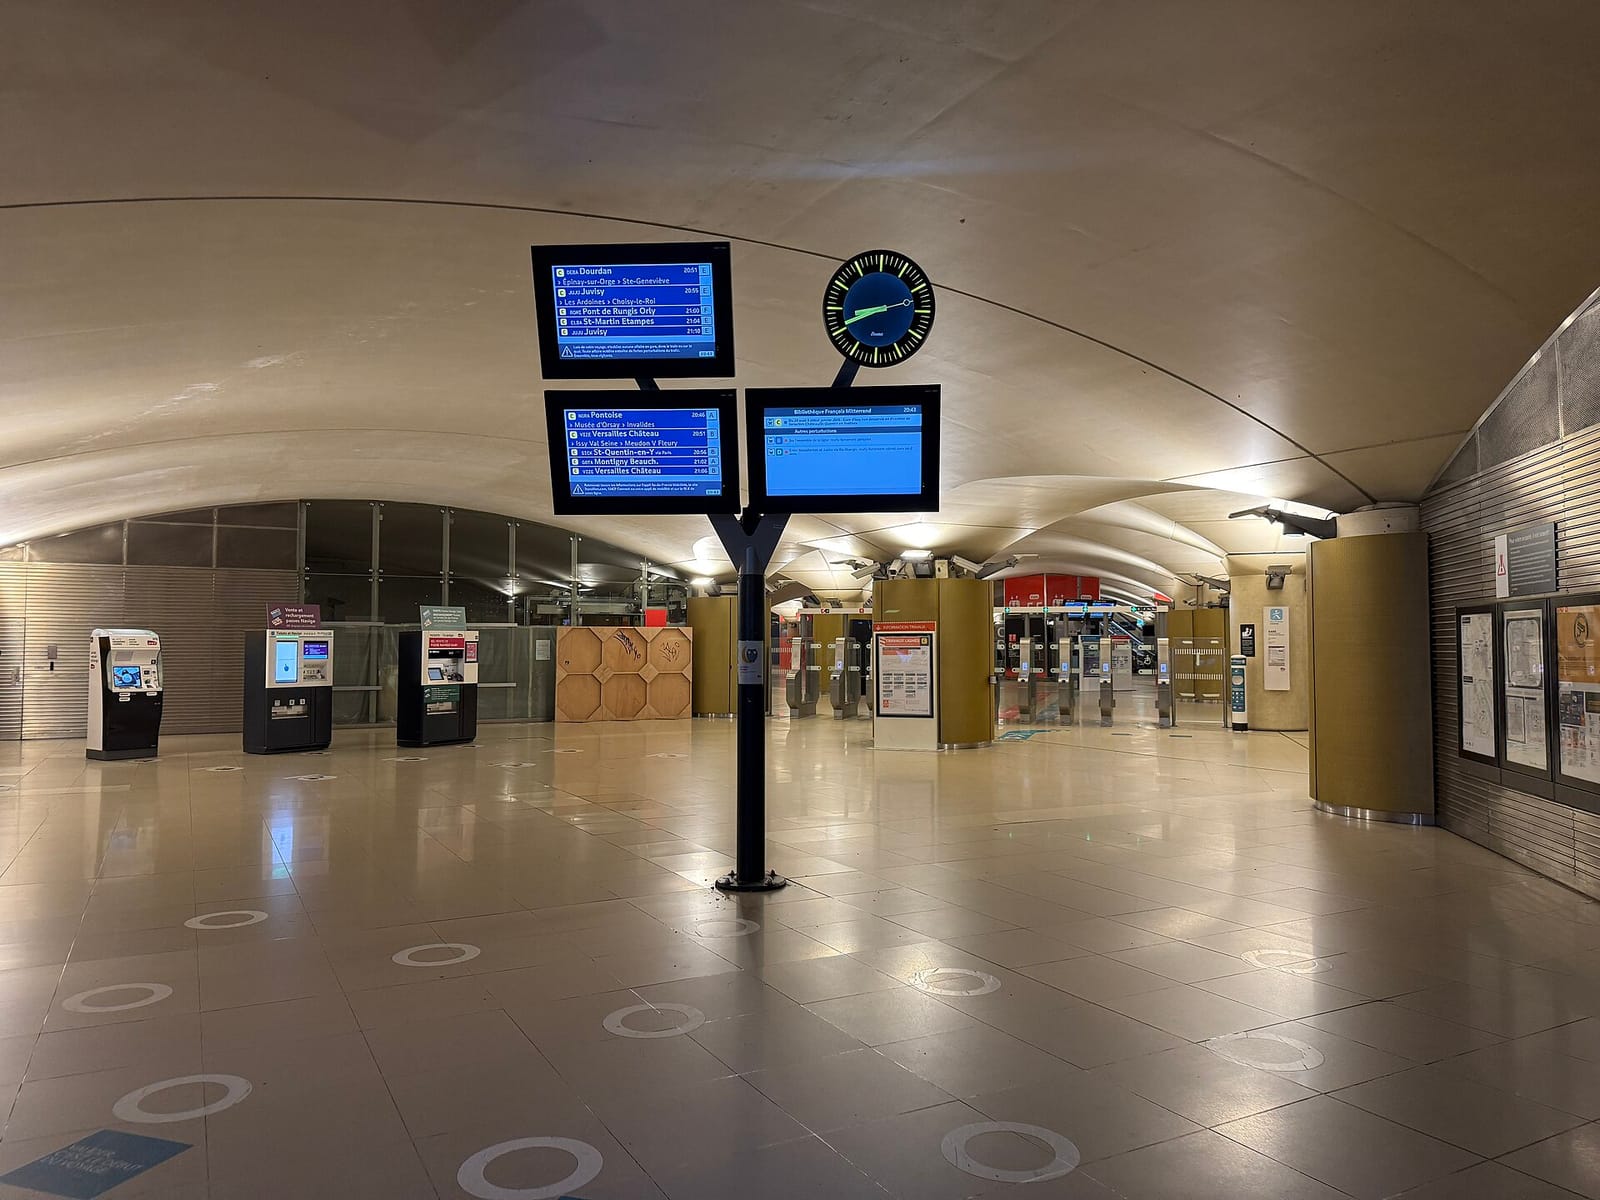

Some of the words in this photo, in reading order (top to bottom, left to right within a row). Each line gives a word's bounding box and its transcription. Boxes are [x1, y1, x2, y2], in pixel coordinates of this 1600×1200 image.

[579, 267, 612, 275] Dourdan
[562, 278, 616, 287] Épinay-sur-Orge
[622, 277, 671, 285] Ste-Geneviève
[580, 288, 605, 297] Juvisy
[612, 297, 656, 306] Choisy-le-Roi
[582, 307, 601, 315] Pont
[613, 307, 639, 317] Rungis
[639, 307, 656, 317] Orly
[621, 317, 655, 327] Etampes
[584, 328, 608, 337] Juvisy
[591, 411, 623, 419] Pontoise
[596, 421, 620, 429] d'Orsay
[658, 440, 678, 448] Fleury
[594, 448, 655, 457] St-Quentin-en-Y
[594, 458, 628, 467] Montigny
